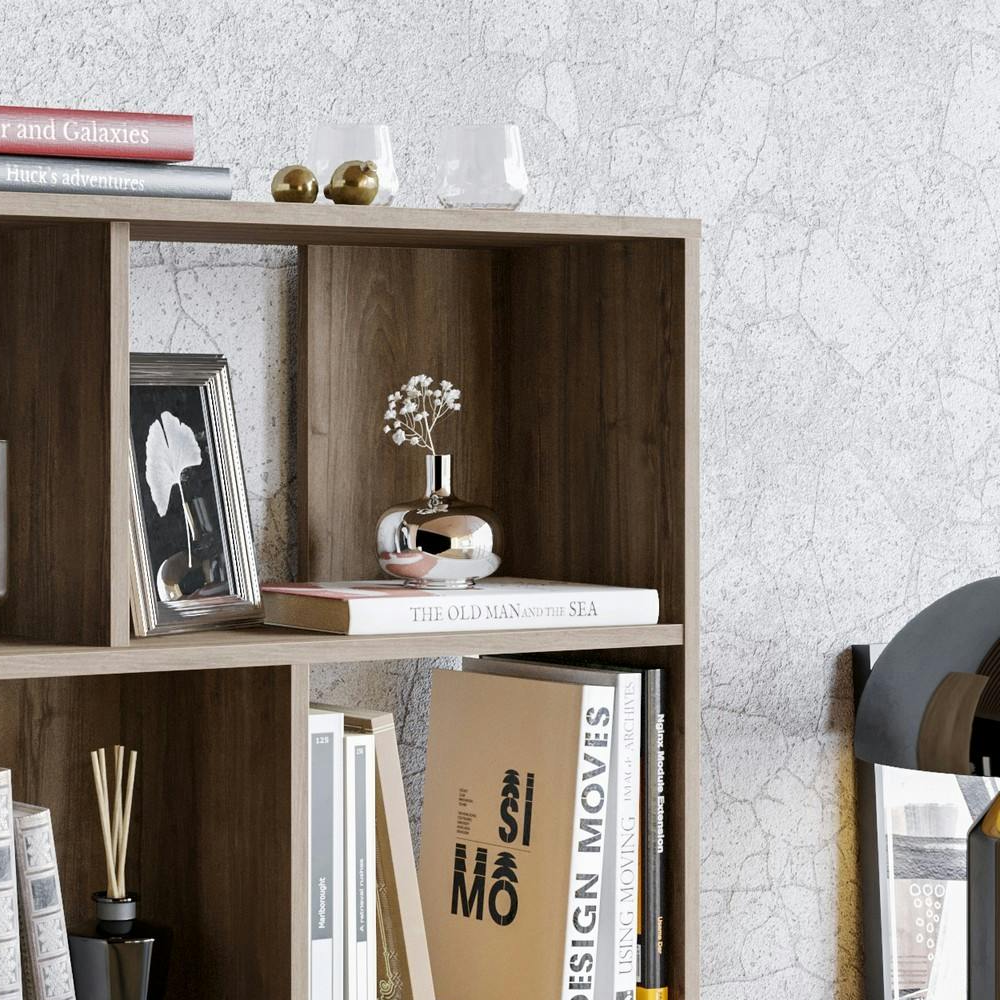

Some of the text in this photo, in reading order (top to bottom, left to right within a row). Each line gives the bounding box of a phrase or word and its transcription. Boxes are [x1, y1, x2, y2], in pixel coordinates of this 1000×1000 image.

[16, 118, 56, 141] and
[63, 120, 150, 144] Galaxies
[6, 163, 145, 191] Huck's adventures
[410, 600, 598, 622] THE OLD MAN AND THE SEA
[623, 680, 636, 751] ARCHIVES
[577, 706, 610, 853] MOVES
[656, 714, 665, 853] Nginx Module Extension
[620, 817, 636, 902] MOVING
[318, 876, 327, 929] Marlborought
[618, 911, 634, 975] USING
